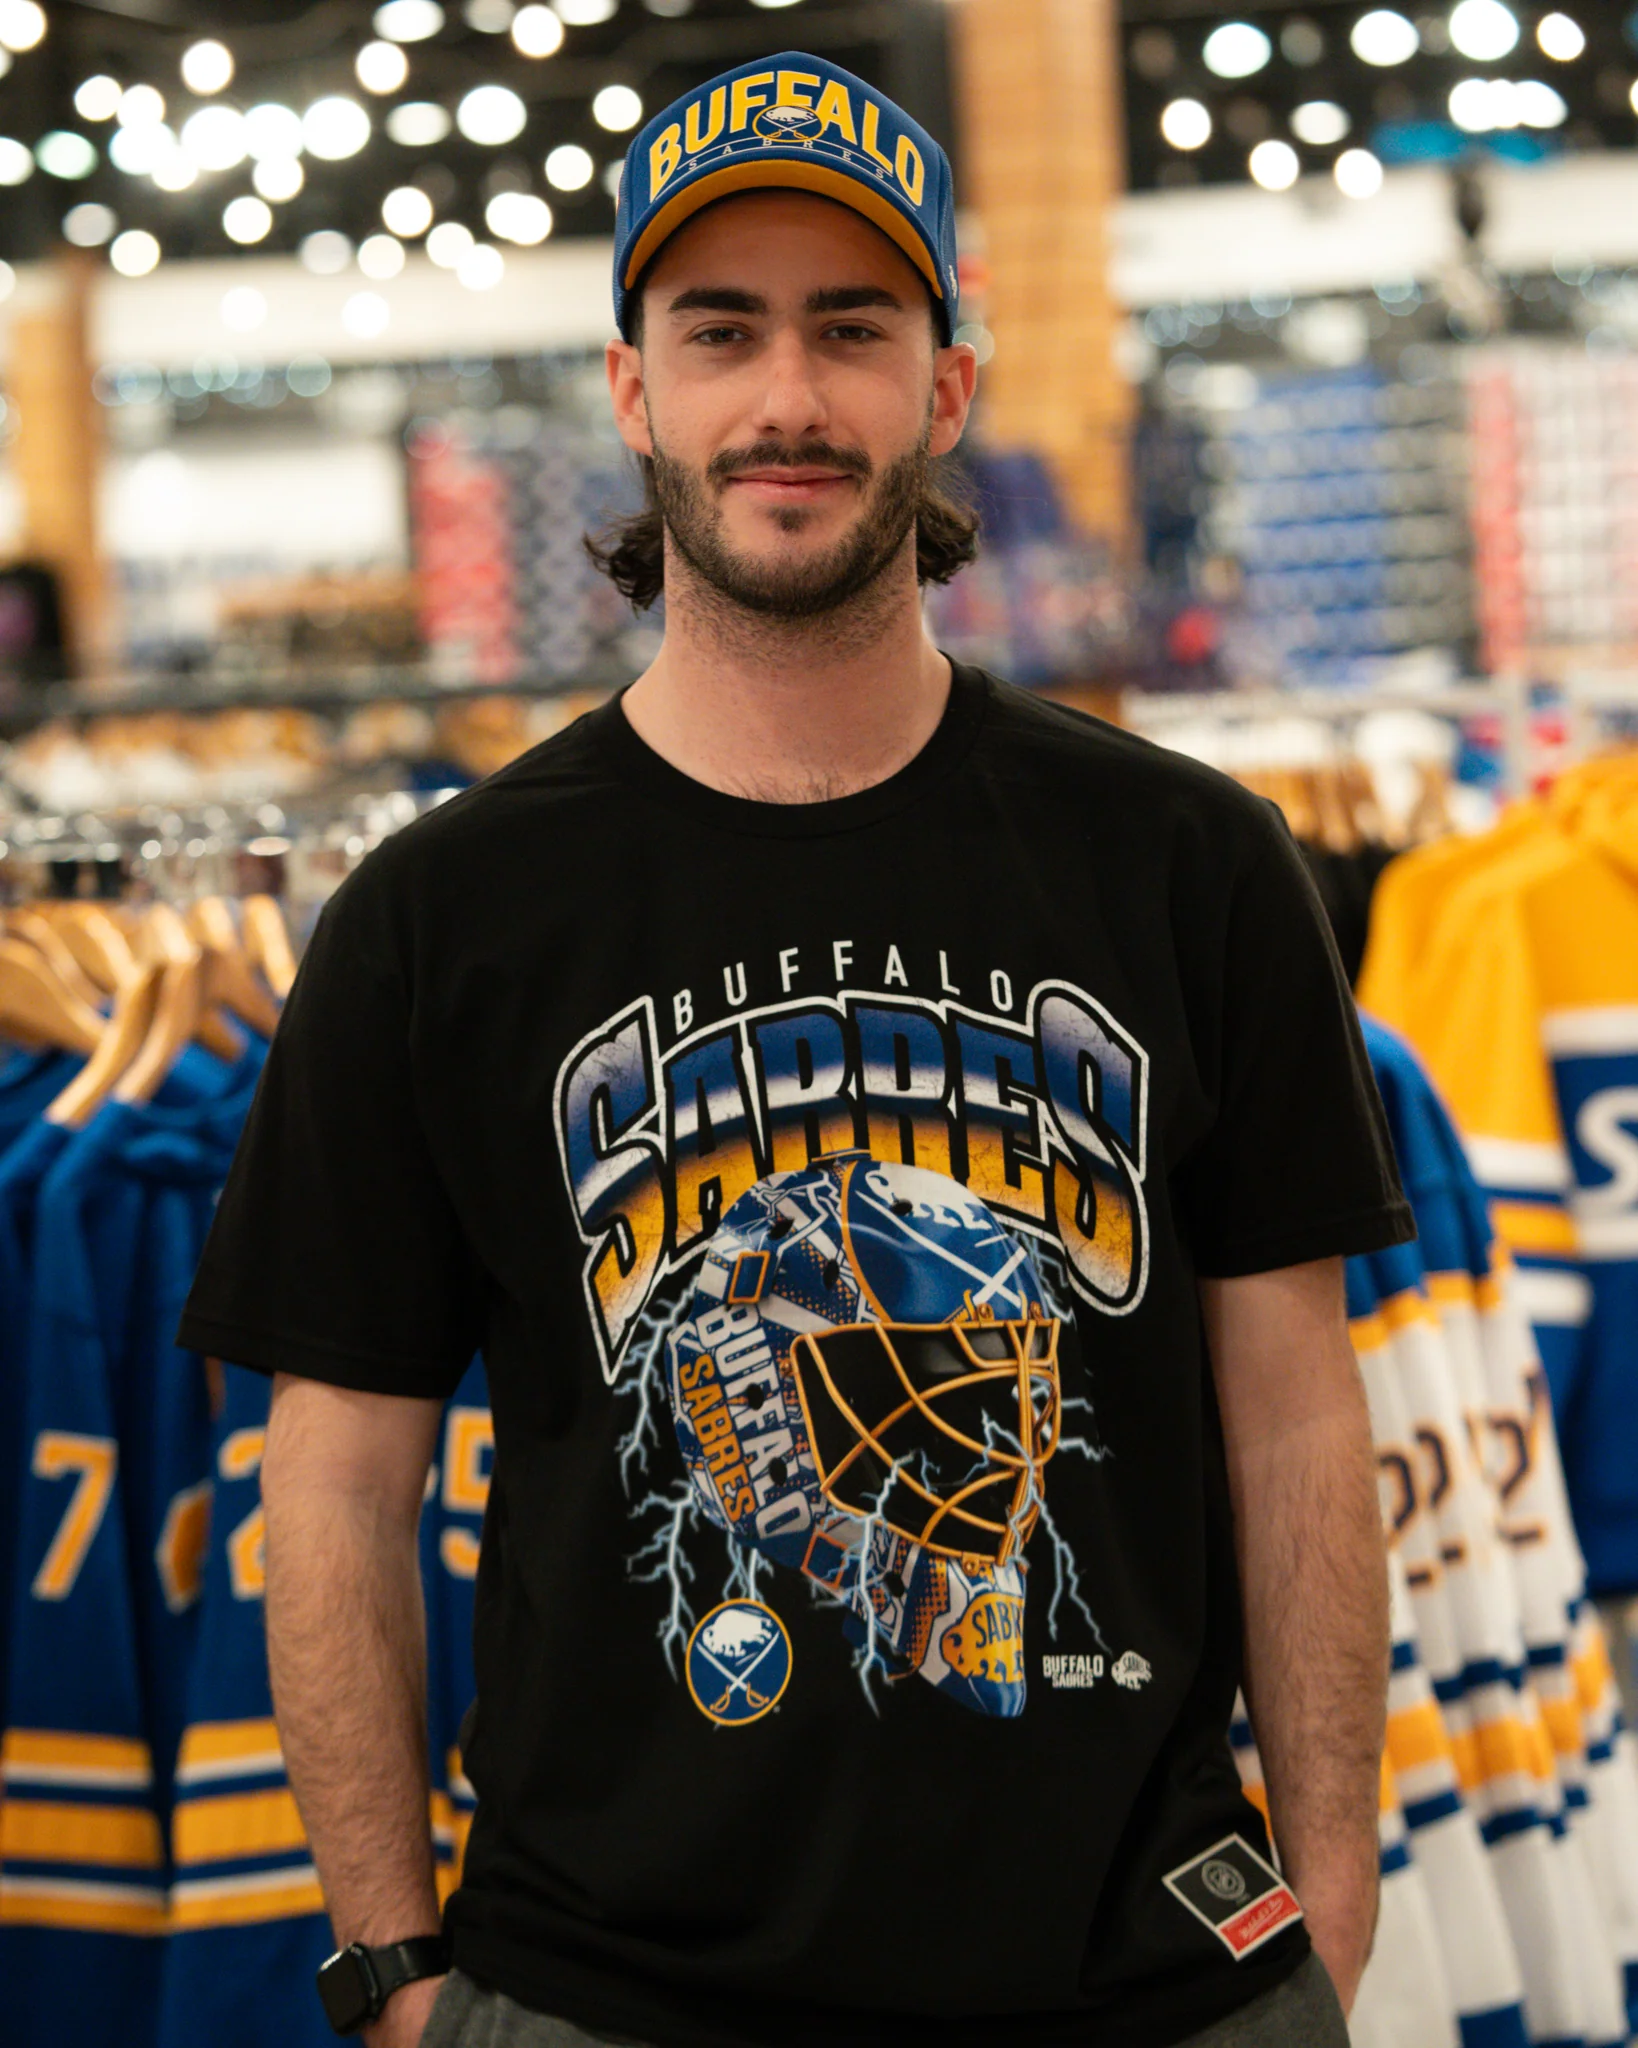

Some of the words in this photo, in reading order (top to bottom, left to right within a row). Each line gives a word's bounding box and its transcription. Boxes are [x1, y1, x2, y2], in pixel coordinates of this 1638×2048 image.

[649, 69, 925, 206] BUFFALO
[689, 137, 885, 179] SABRES
[674, 940, 1013, 1034] BUFFALO
[553, 978, 1150, 1385] SABRES
[425, 1406, 496, 1580] 5
[679, 1353, 757, 1523] SABRES
[696, 1303, 812, 1540] BUFFALO
[32, 1430, 118, 1601] 7
[1042, 1654, 1104, 1679] BUFFALO
